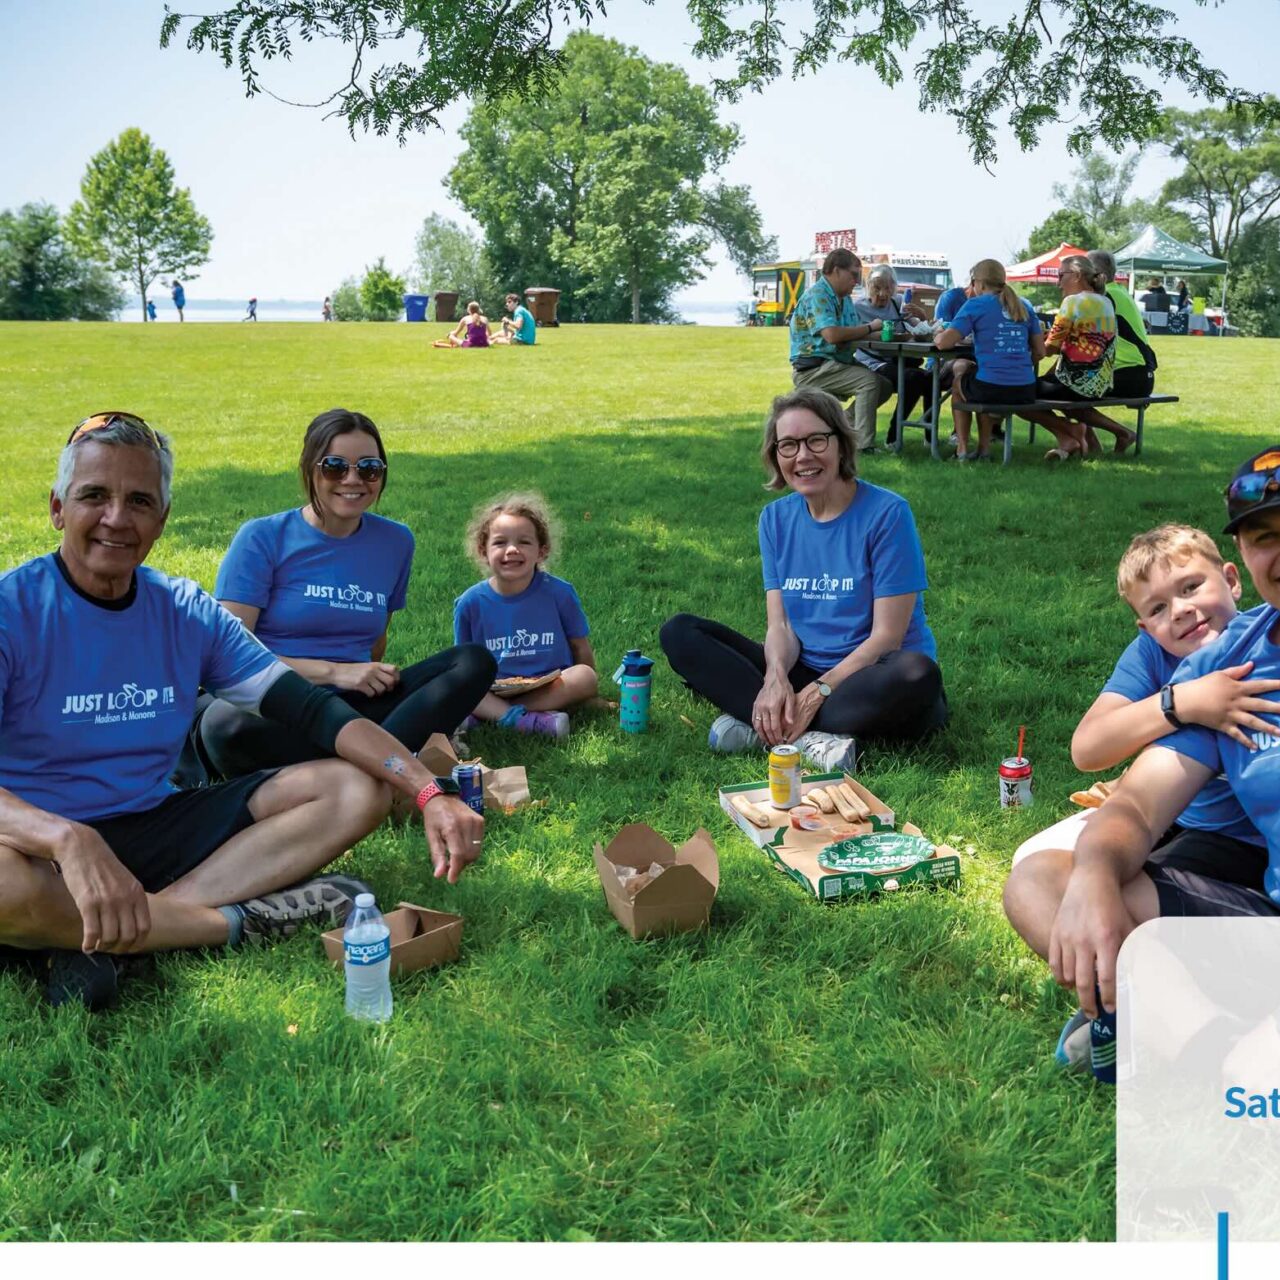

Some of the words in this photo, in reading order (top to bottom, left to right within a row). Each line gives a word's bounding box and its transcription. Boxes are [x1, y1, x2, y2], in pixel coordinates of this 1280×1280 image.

[782, 578, 809, 590] JUST
[811, 578, 839, 591] LOOP
[842, 578, 854, 591] IT!
[303, 585, 335, 598] JUST
[337, 588, 374, 603] LOOP
[507, 633, 539, 648] LOOP
[541, 633, 554, 645] IT!
[62, 694, 104, 714] JUST
[107, 686, 158, 710] LOOP
[162, 686, 175, 704] IT!
[95, 712, 120, 724] Madison
[121, 712, 127, 721] &
[129, 711, 156, 721] Monona
